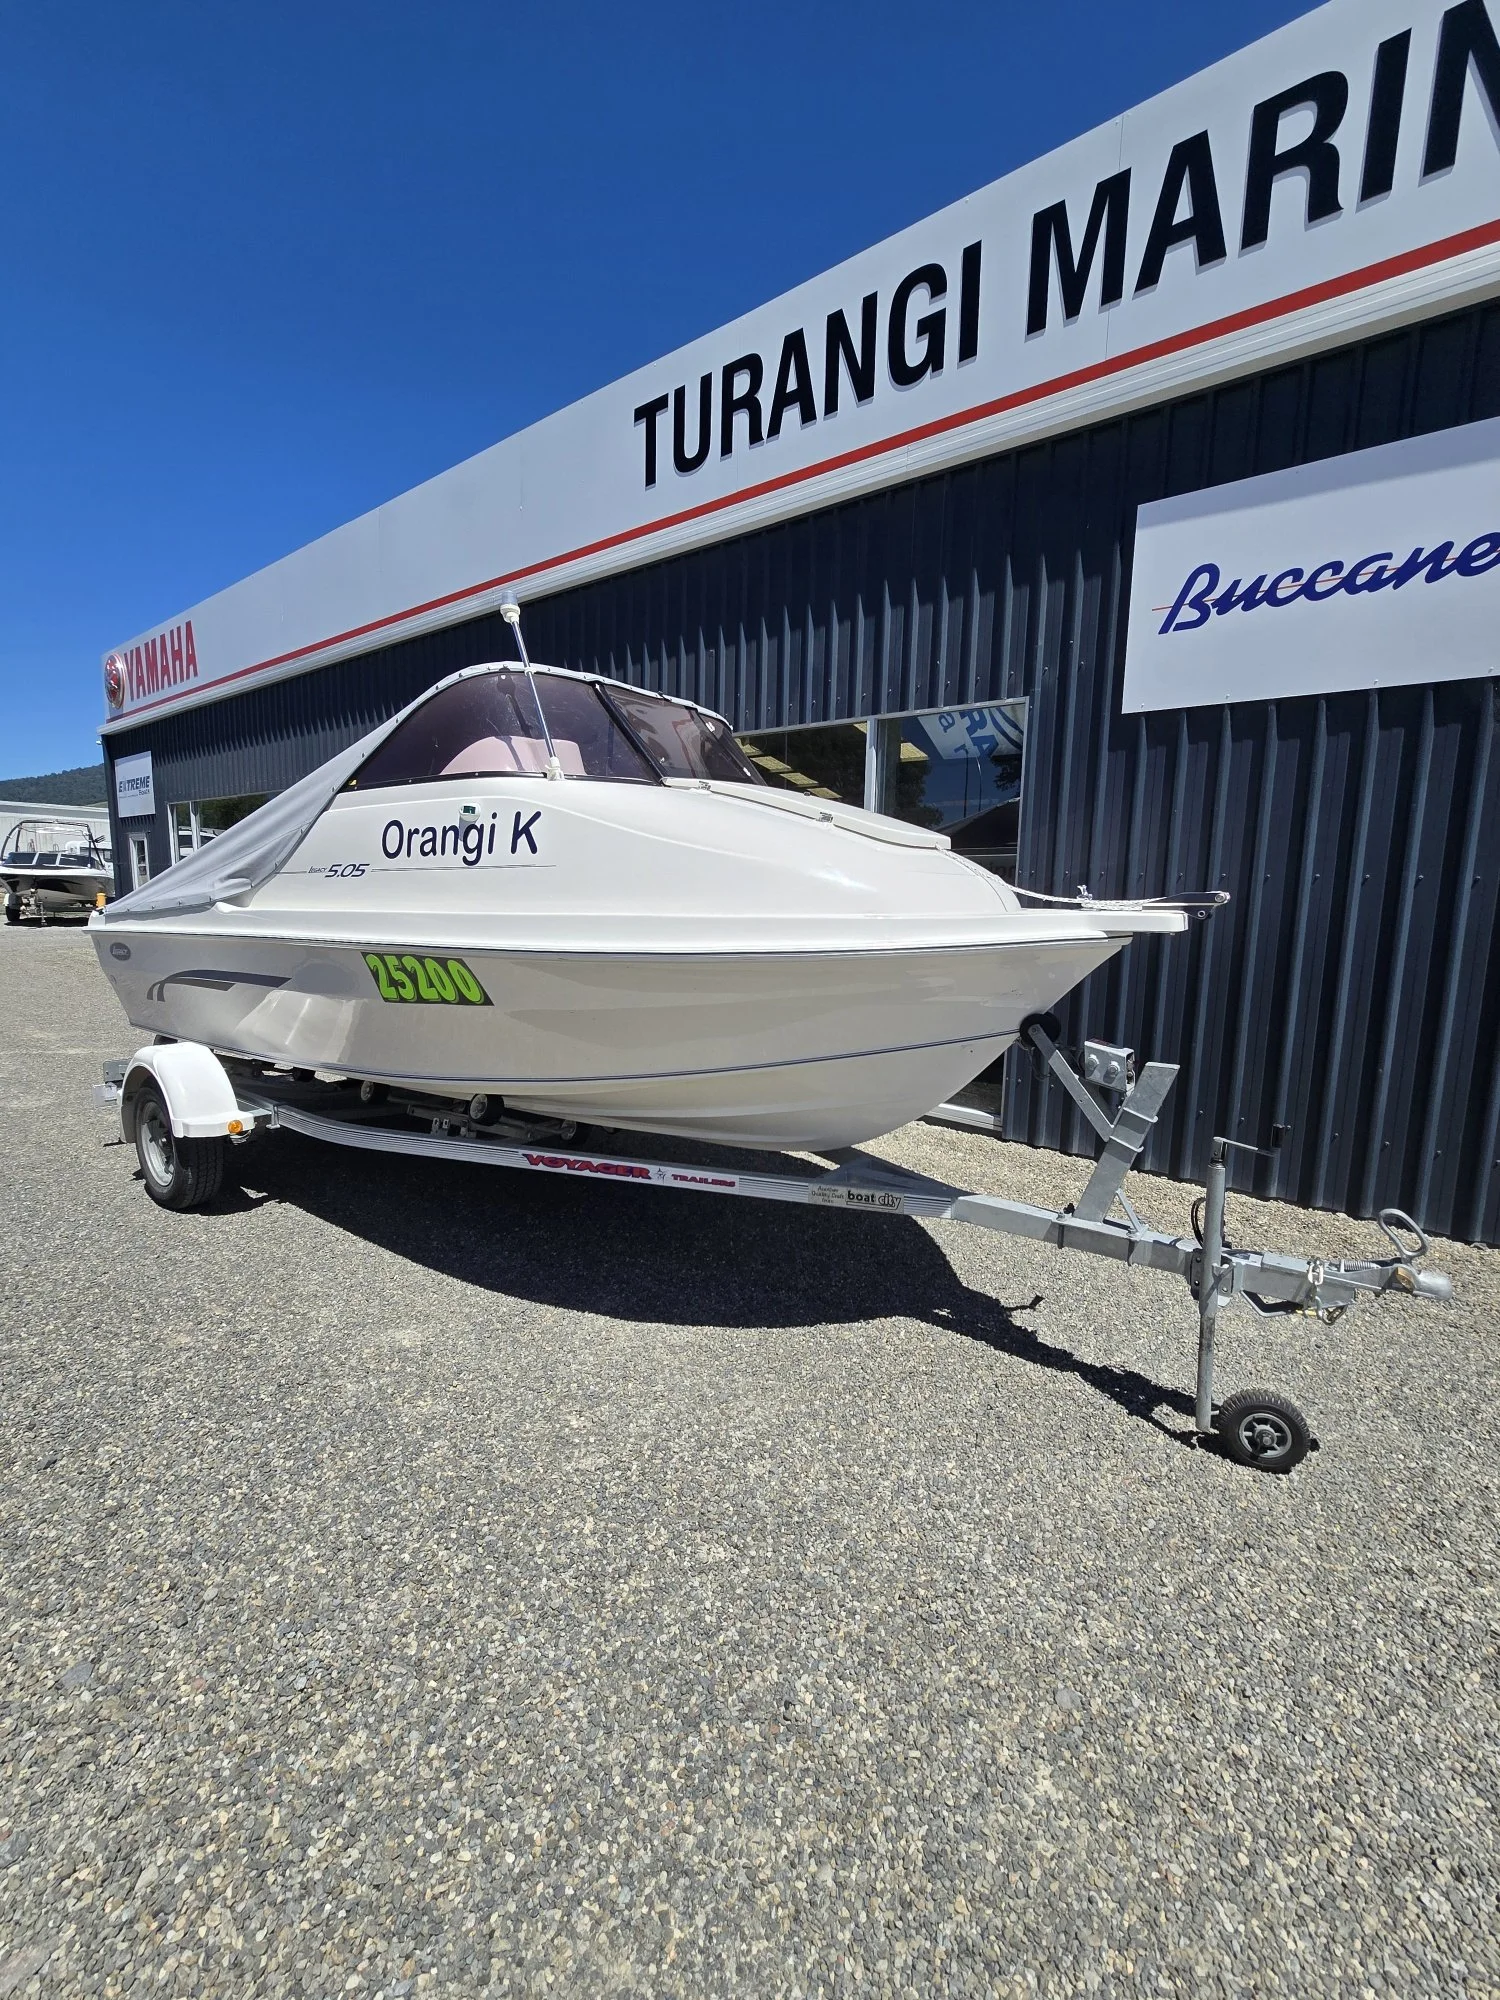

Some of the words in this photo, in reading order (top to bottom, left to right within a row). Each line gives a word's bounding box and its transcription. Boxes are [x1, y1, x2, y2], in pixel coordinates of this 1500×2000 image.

[633, 239, 983, 489] TURANGI
[1157, 531, 1500, 635] Buccane
[124, 620, 198, 702] YAMAHA
[118, 775, 151, 793] EXTREME
[381, 811, 498, 867] Orangi
[510, 810, 543, 855] K
[325, 863, 371, 878] 5.05
[364, 953, 485, 1004] 25200
[522, 1153, 652, 1180] VOYAGER
[671, 1173, 736, 1188] TRAILERS
[847, 1190, 875, 1203] boat
[877, 1192, 902, 1209] city
